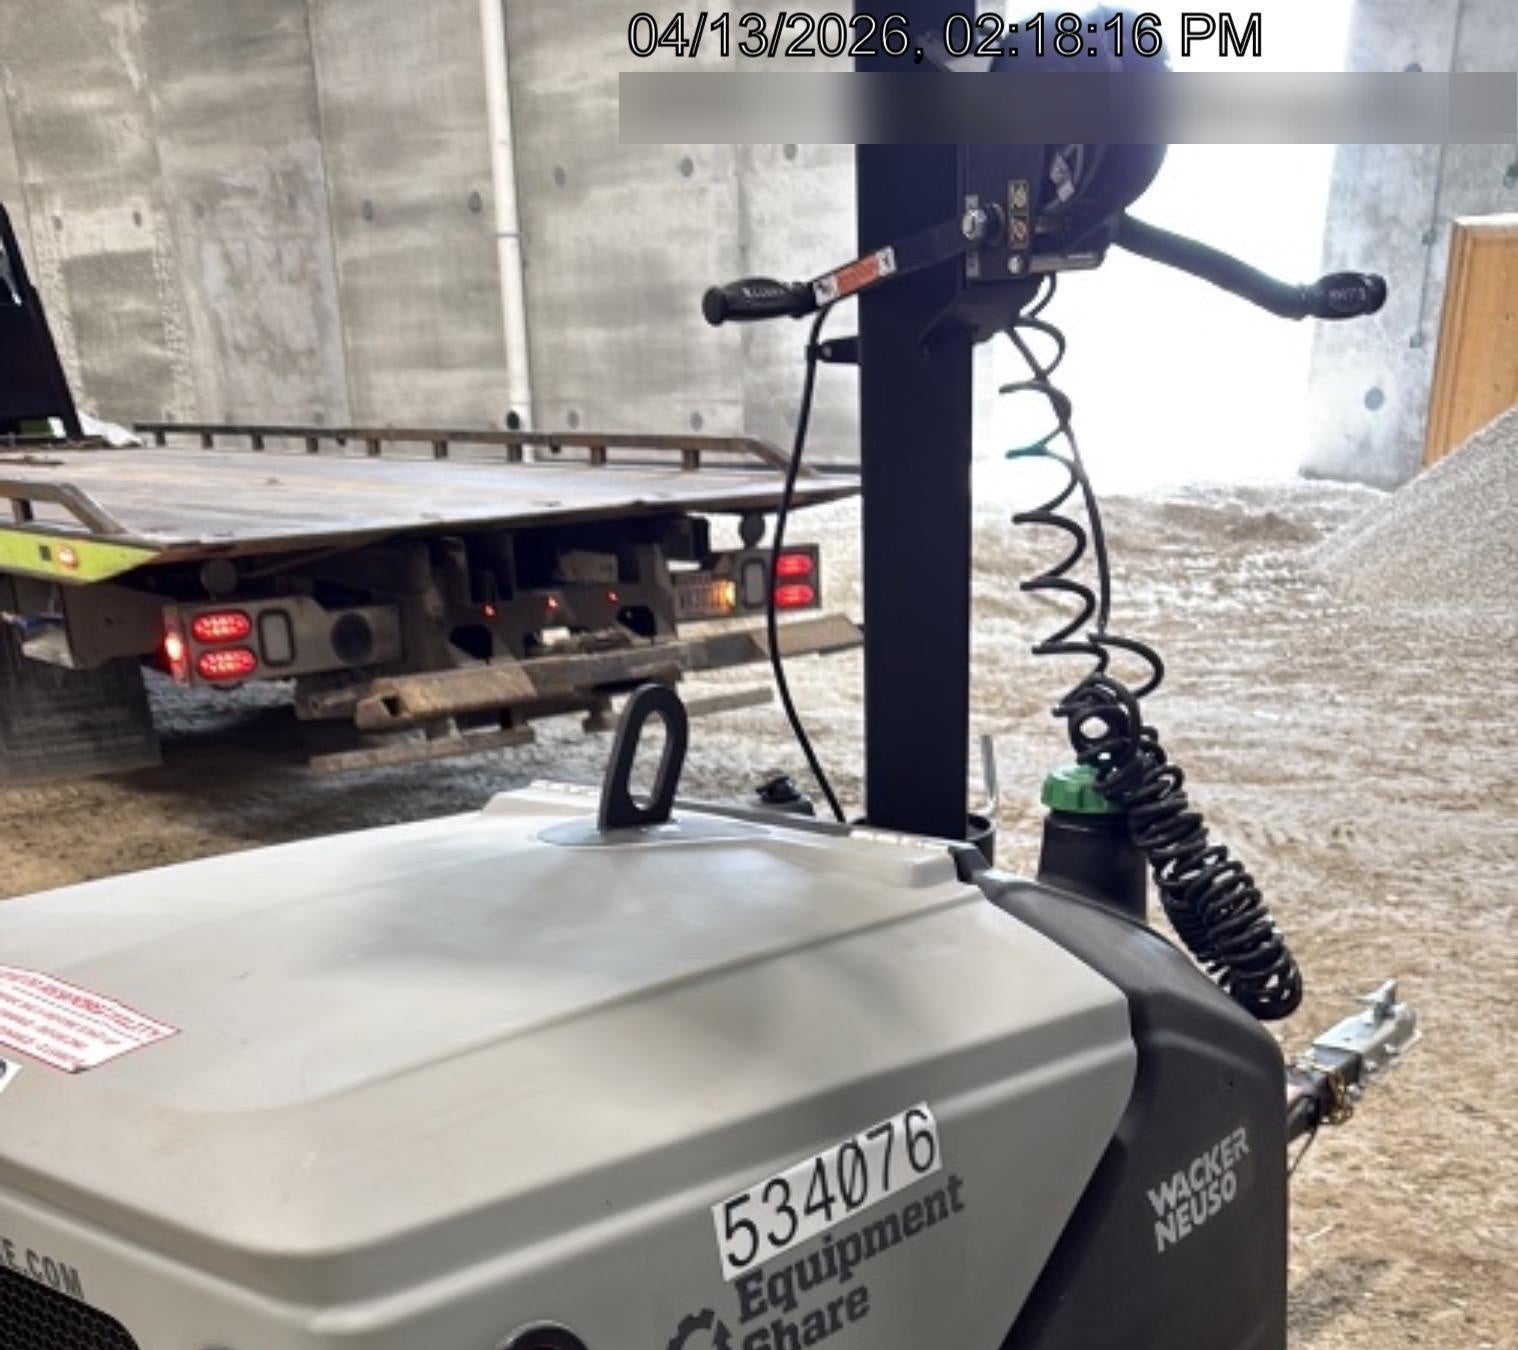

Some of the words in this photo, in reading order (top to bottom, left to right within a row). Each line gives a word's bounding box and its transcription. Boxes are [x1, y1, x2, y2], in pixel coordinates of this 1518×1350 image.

[722, 1108, 936, 1268] 534076
[1146, 1126, 1250, 1217] WACKER
[0, 1236, 85, 1300] E.COM
[734, 1174, 965, 1324] Equipment
